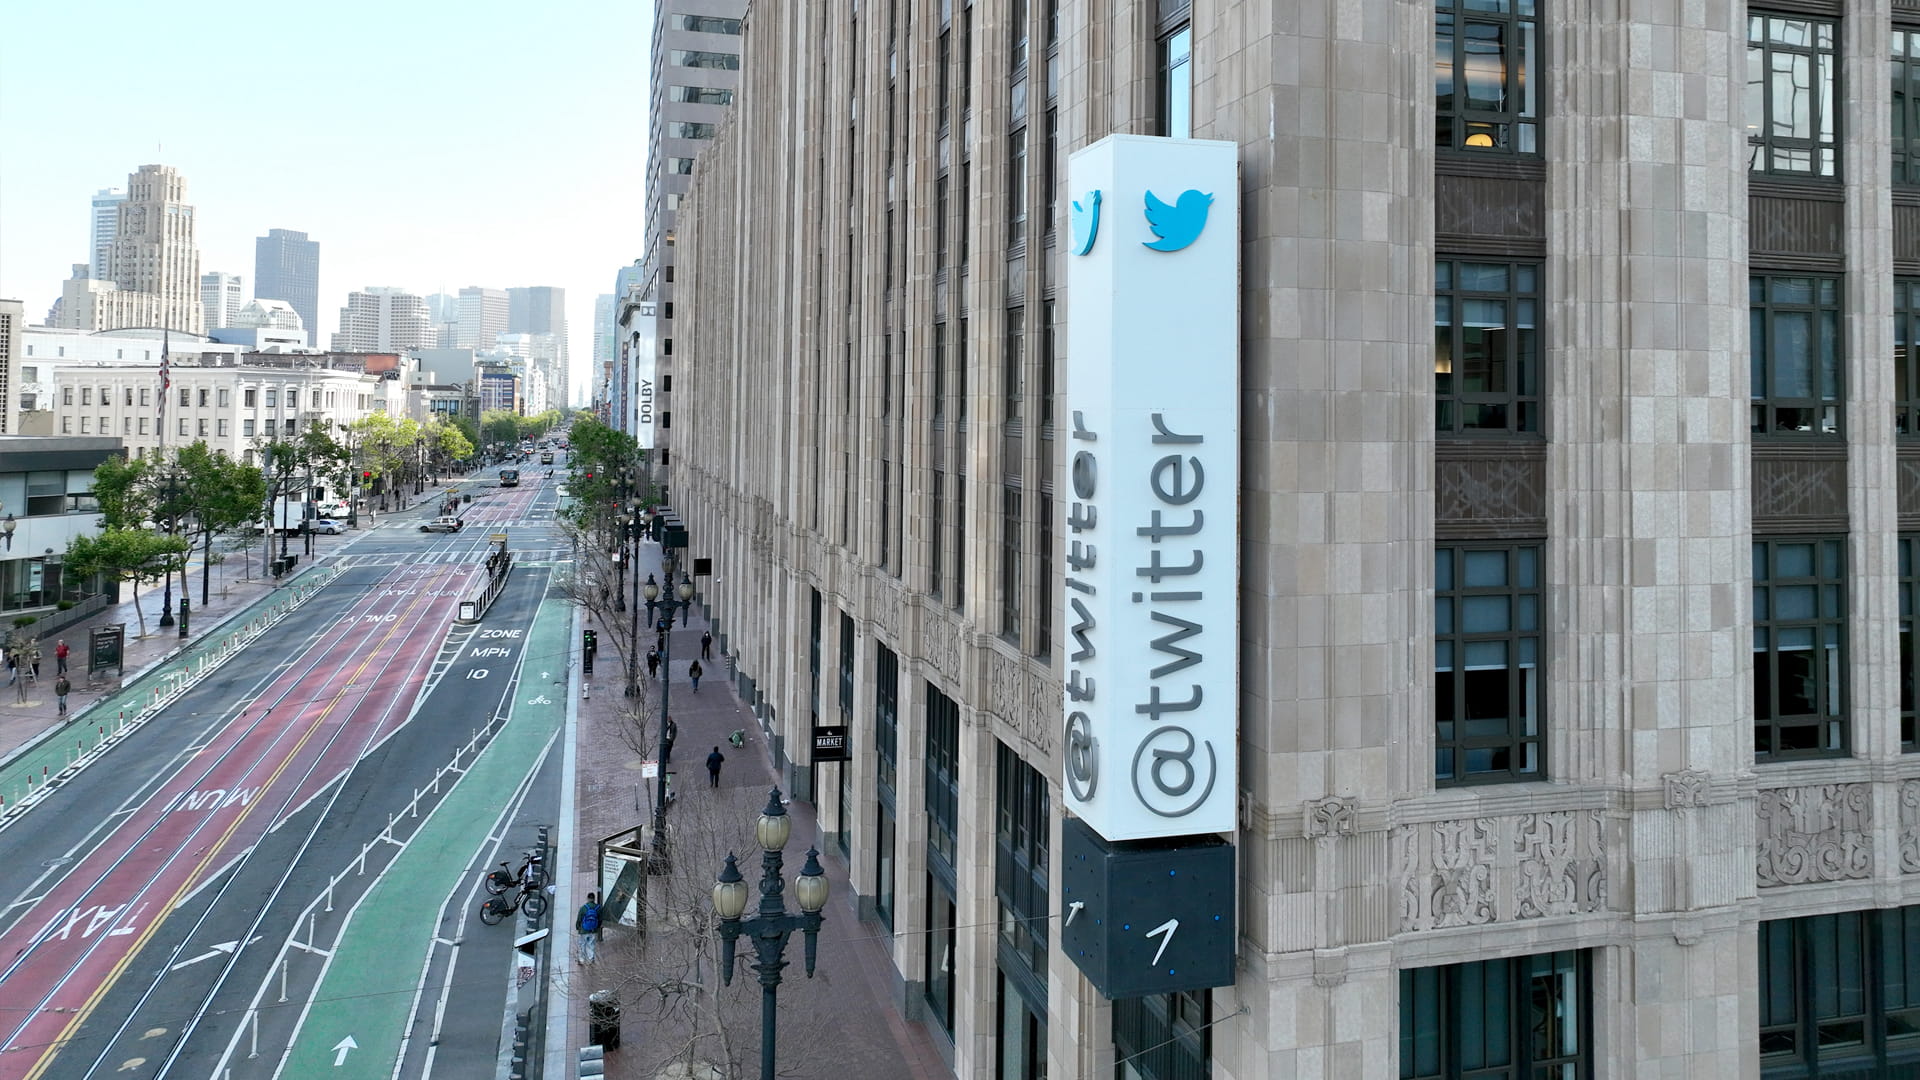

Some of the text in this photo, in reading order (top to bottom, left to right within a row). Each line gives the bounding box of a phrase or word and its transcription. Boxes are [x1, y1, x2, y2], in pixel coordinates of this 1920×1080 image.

[641, 379, 652, 424] DOLBY
[1063, 410, 1099, 802] @twitter
[1132, 412, 1217, 818] @twitter
[343, 614, 397, 623] ONLY
[480, 629, 522, 639] ZONE
[470, 647, 511, 658] MPH
[465, 668, 489, 680] 10
[816, 737, 843, 747] MARKET
[161, 786, 260, 812] MUNI
[27, 901, 149, 944] TAXI
